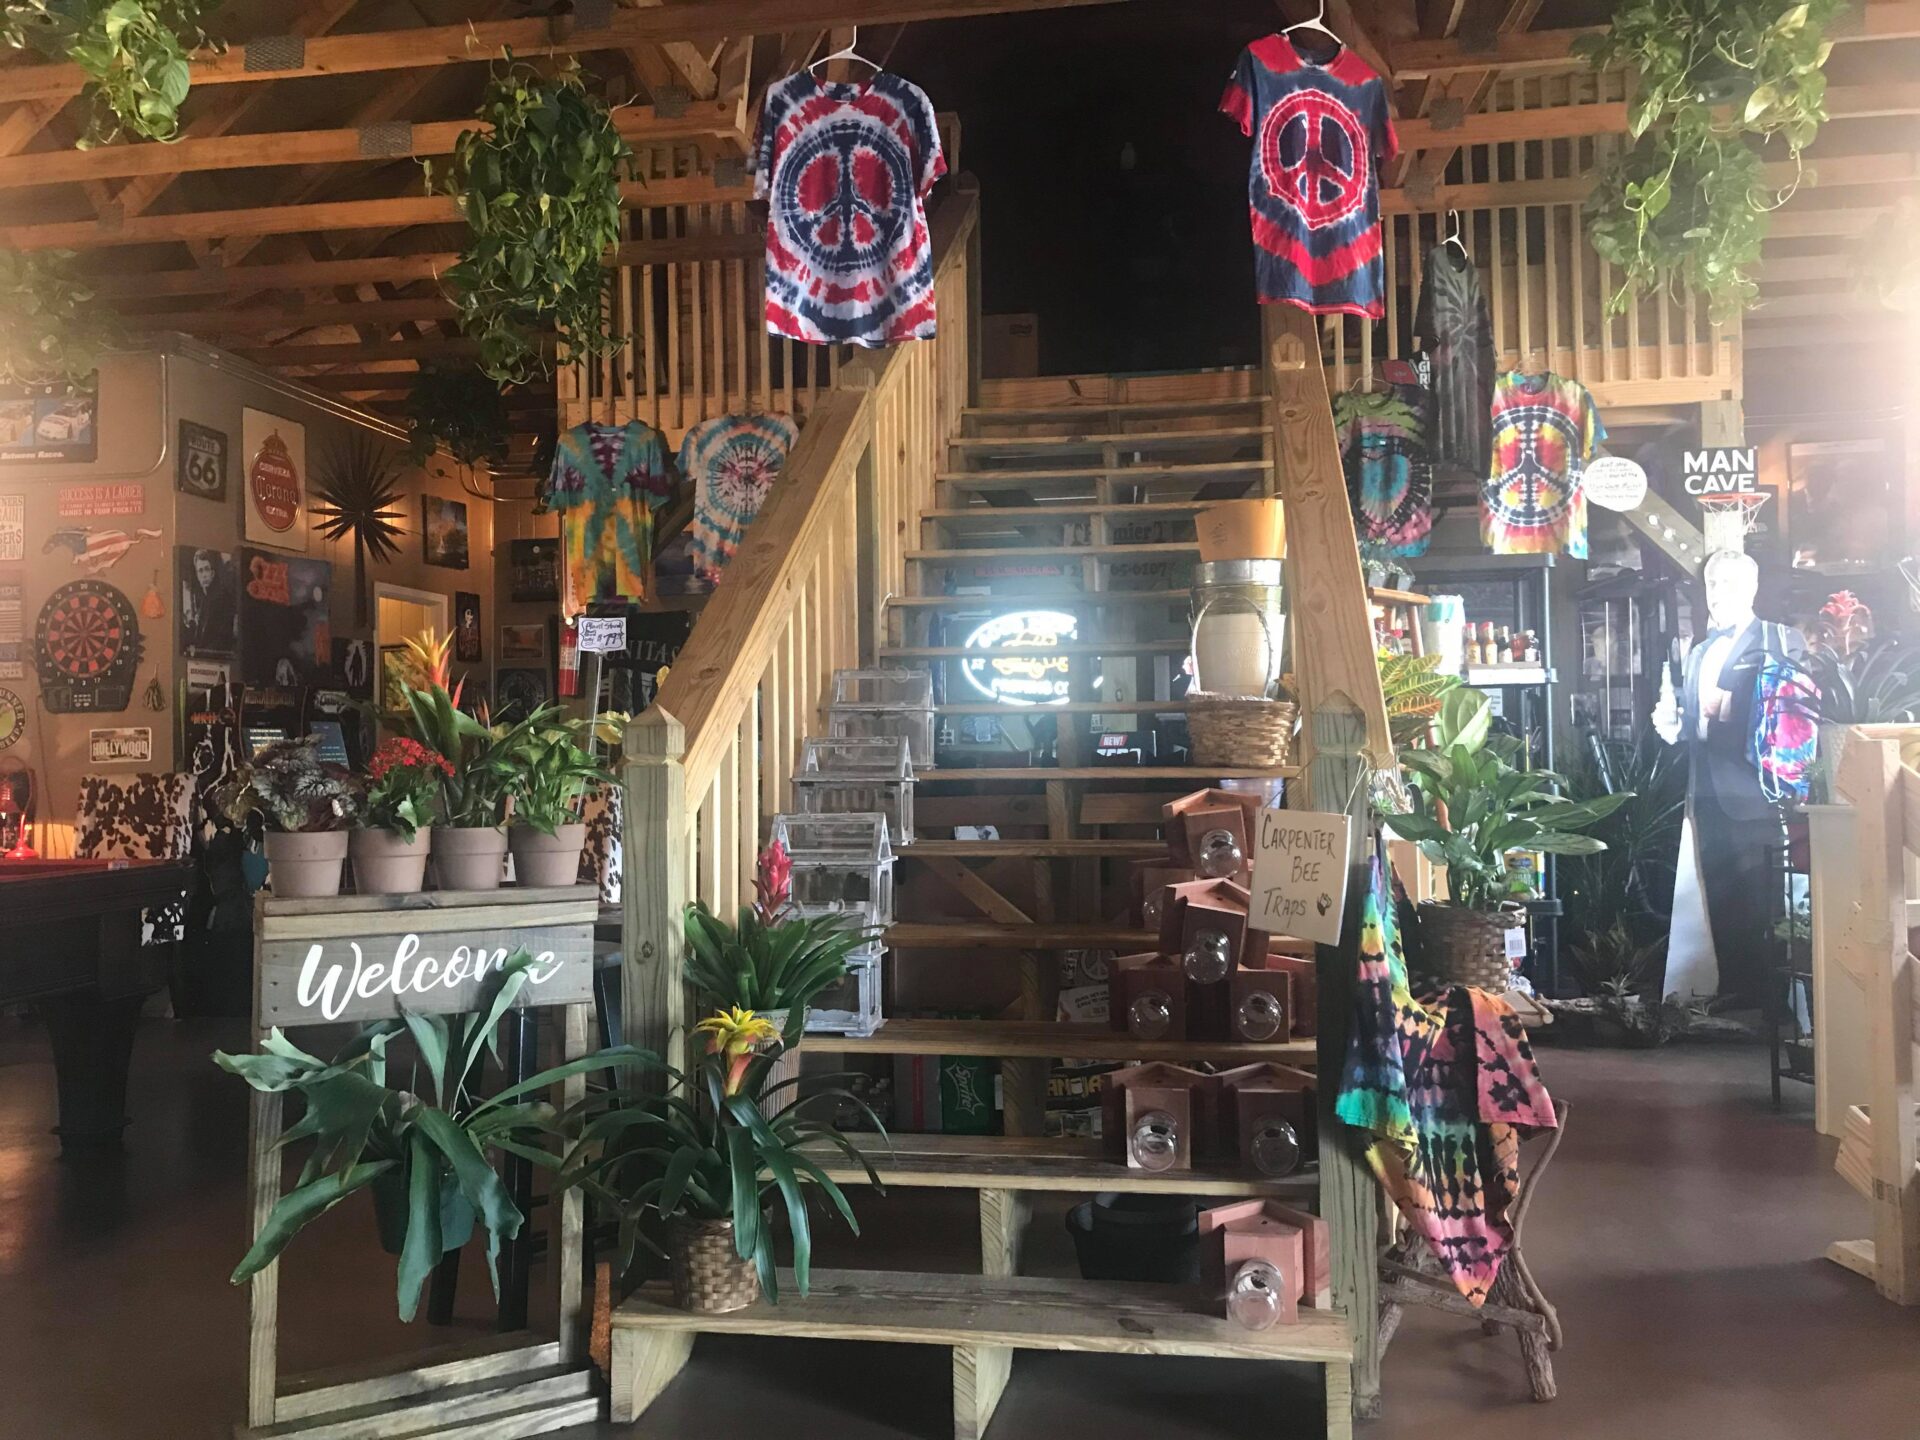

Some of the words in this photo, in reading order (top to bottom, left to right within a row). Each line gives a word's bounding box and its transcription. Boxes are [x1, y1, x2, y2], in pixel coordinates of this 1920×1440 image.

[188, 452, 217, 487] 66
[259, 461, 291, 478] CERVEZA
[1684, 449, 1755, 474] MAN
[59, 487, 94, 501] SUCCESS
[95, 487, 103, 500] IS
[112, 484, 143, 499] LADDER
[255, 475, 298, 505] Corona
[1684, 473, 1755, 495] CAVE
[265, 505, 289, 518] EXTRA
[92, 740, 148, 757] HOLLYWOOD
[1103, 735, 1124, 746] NEW!
[1261, 813, 1337, 860] CARPENTER
[1291, 855, 1321, 883] BEE
[1263, 887, 1308, 929] TRAPS
[955, 1064, 972, 1109] Sprite
